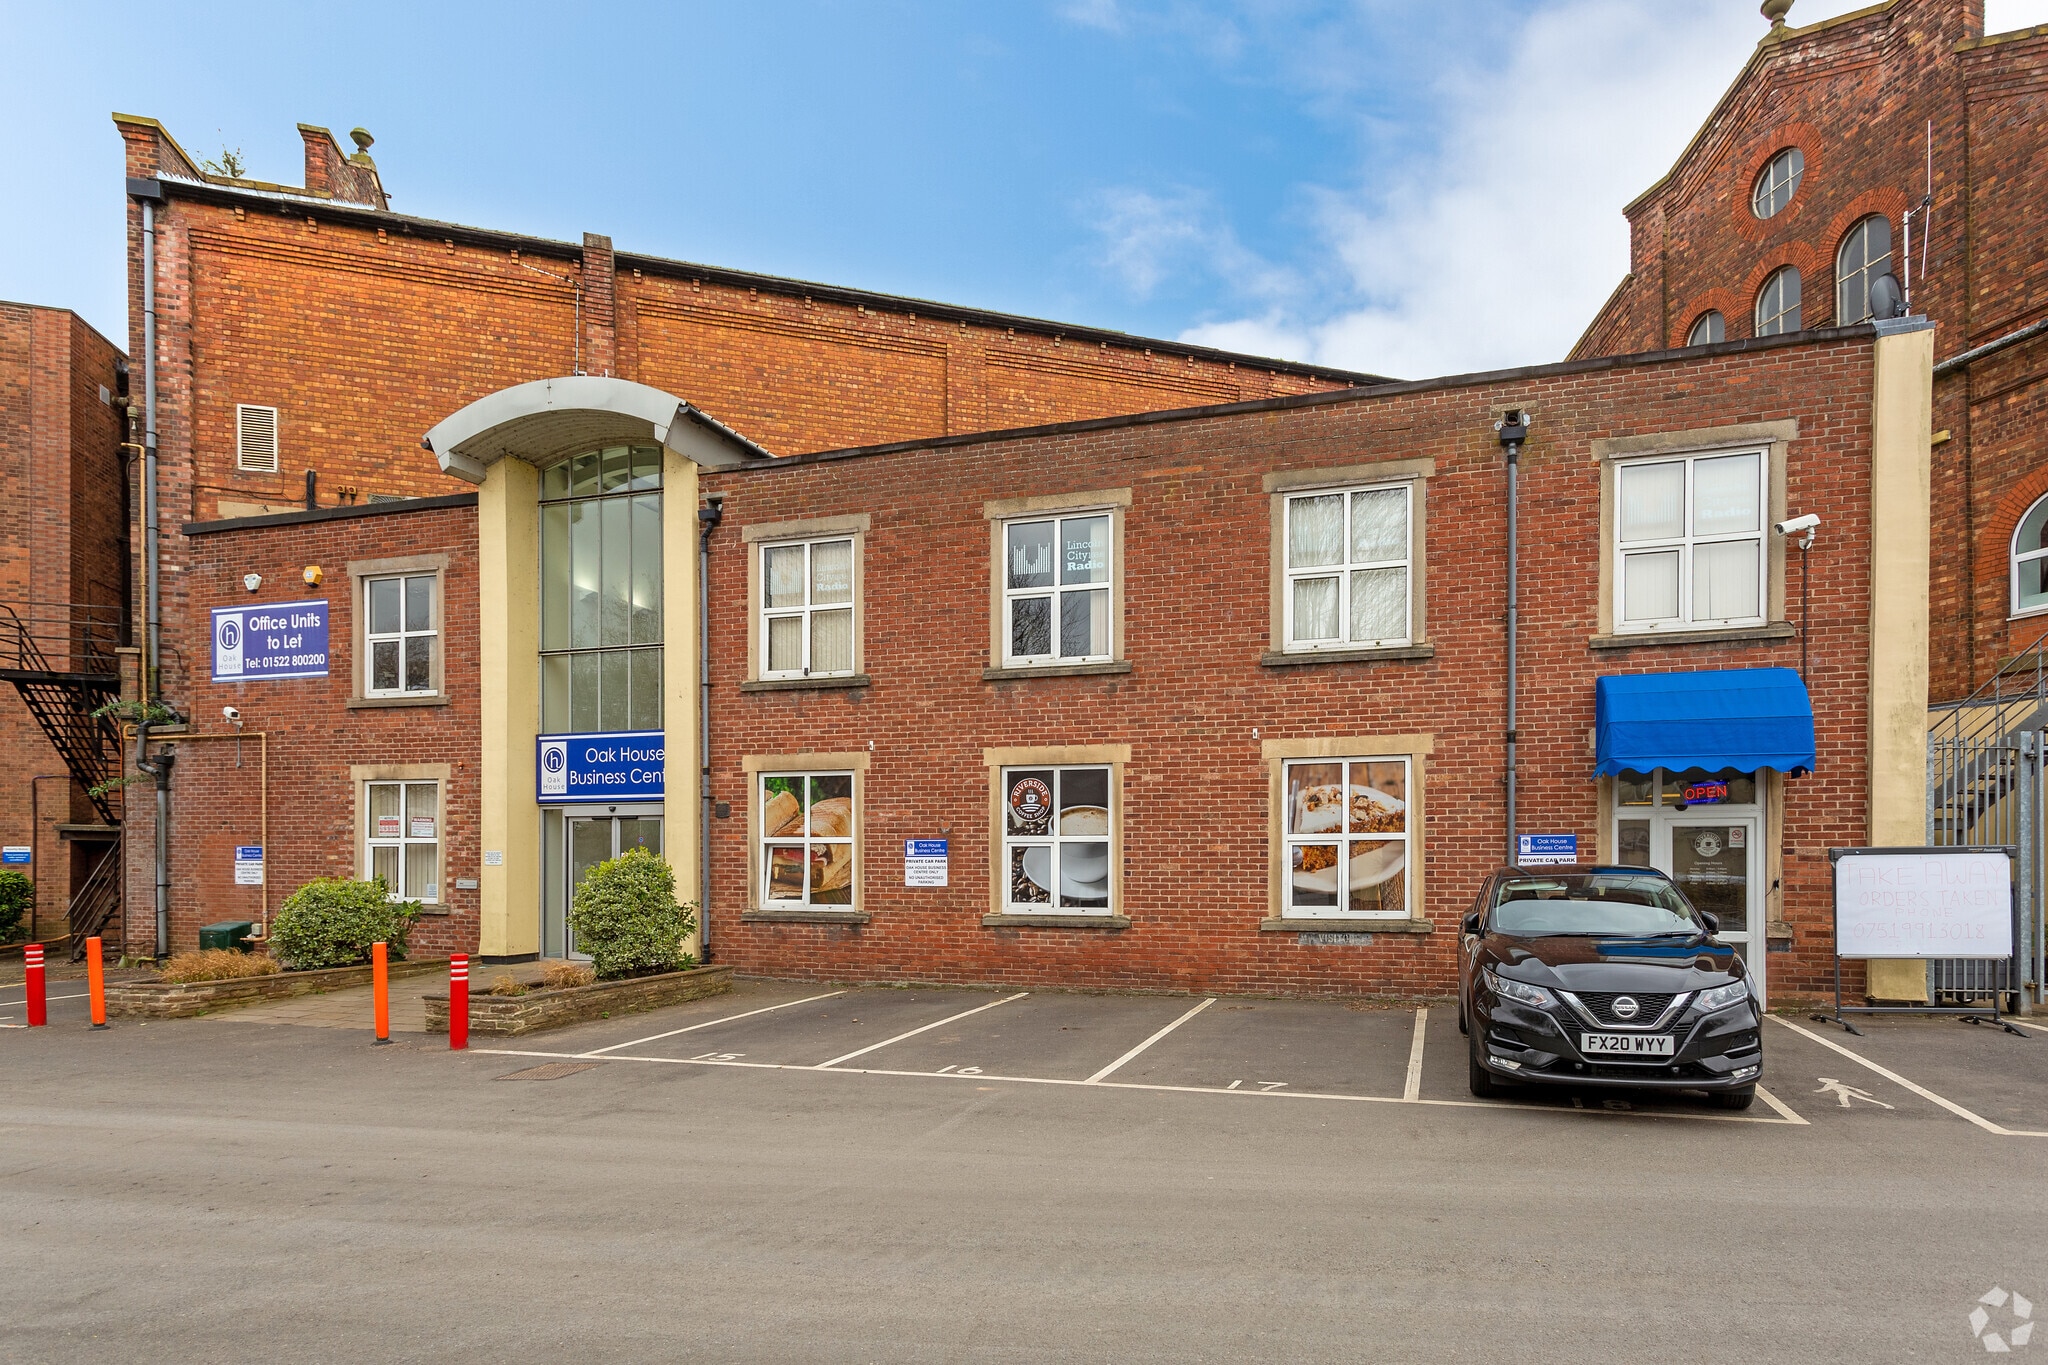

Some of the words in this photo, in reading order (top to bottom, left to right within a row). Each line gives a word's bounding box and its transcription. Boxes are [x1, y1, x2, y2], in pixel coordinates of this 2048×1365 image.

[1067, 560, 1104, 571] Radio
[816, 581, 849, 592] Radio
[249, 615, 288, 632] Office
[291, 612, 321, 629] Units
[267, 635, 280, 650] to
[283, 633, 303, 649] Let
[222, 654, 238, 662] Oak
[245, 657, 261, 669] Tel:
[262, 655, 290, 668] 01522
[292, 653, 325, 667] 800200
[218, 663, 242, 671] House
[585, 747, 617, 763] Oak
[620, 746, 665, 762] House
[547, 776, 561, 784] Oak
[569, 769, 627, 785] Business
[1013, 780, 1048, 797] RIVERSIDE
[1684, 785, 1727, 800] OPEN
[1016, 807, 1033, 819] COFFEE
[1841, 862, 1916, 886] TAKE
[1924, 860, 2007, 886] AWAY
[1859, 891, 1930, 907] ORDERS
[1937, 889, 1999, 906] TAKEN
[1588, 1035, 1630, 1051] FX20
[1634, 1037, 1666, 1052] WYY
[689, 1052, 747, 1061] 15
[936, 1064, 983, 1075] 16
[1226, 1079, 1289, 1092] 17
